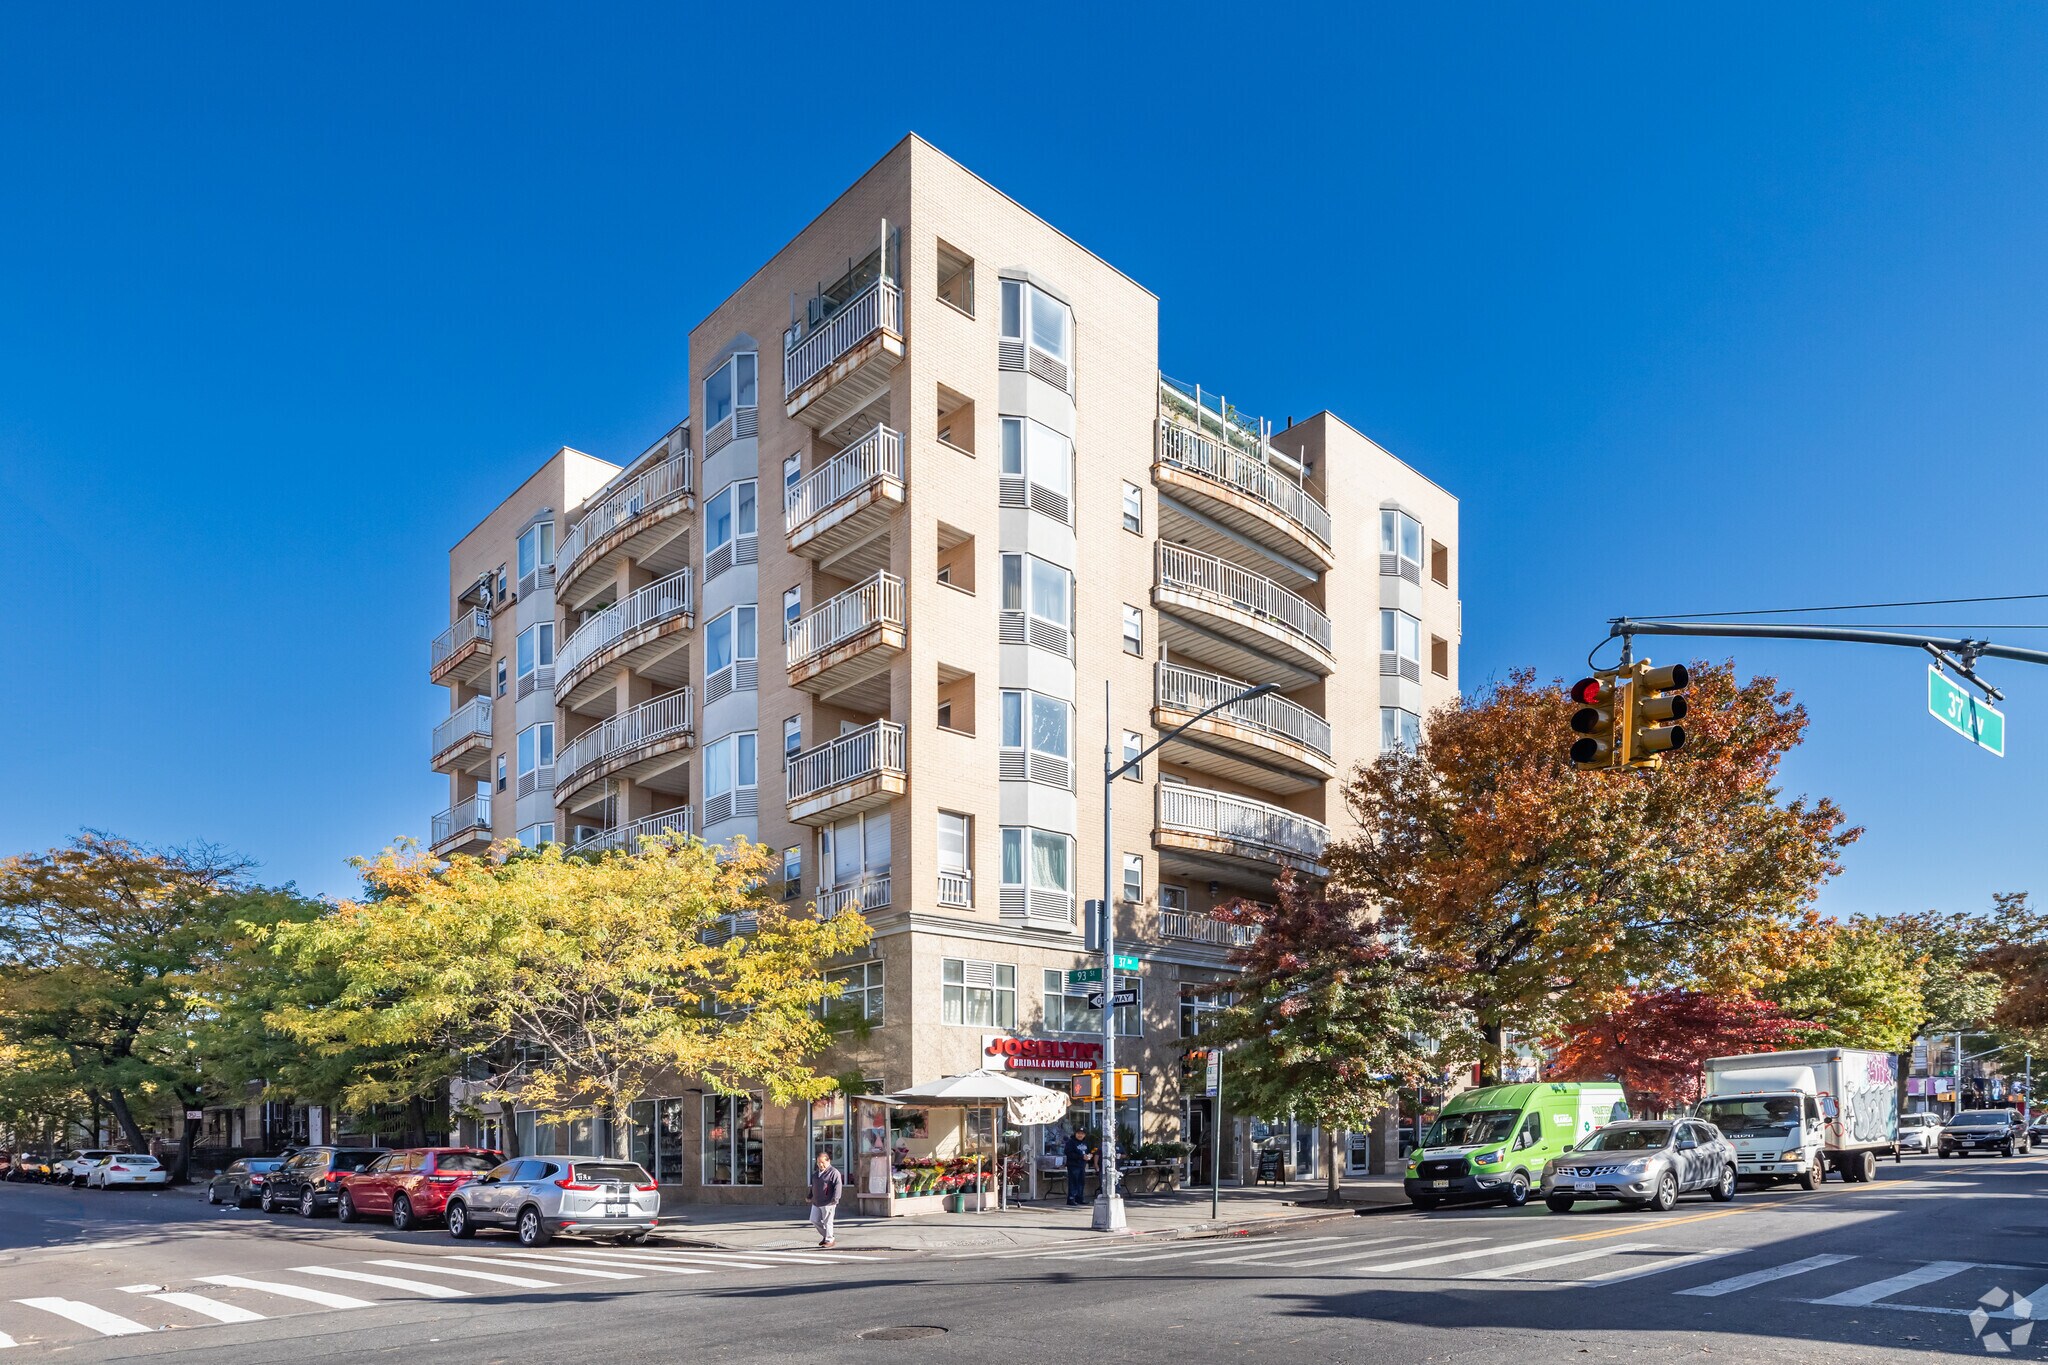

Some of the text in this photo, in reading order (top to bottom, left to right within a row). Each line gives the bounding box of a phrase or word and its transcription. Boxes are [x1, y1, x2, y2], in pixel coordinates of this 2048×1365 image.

[1948, 691, 1984, 736] 37 AV
[1118, 957, 1126, 968] 37
[1077, 971, 1087, 981] 93
[1114, 994, 1131, 1003] WAY
[1013, 1058, 1093, 1070] BRIDAL & FLOWER SHOP
